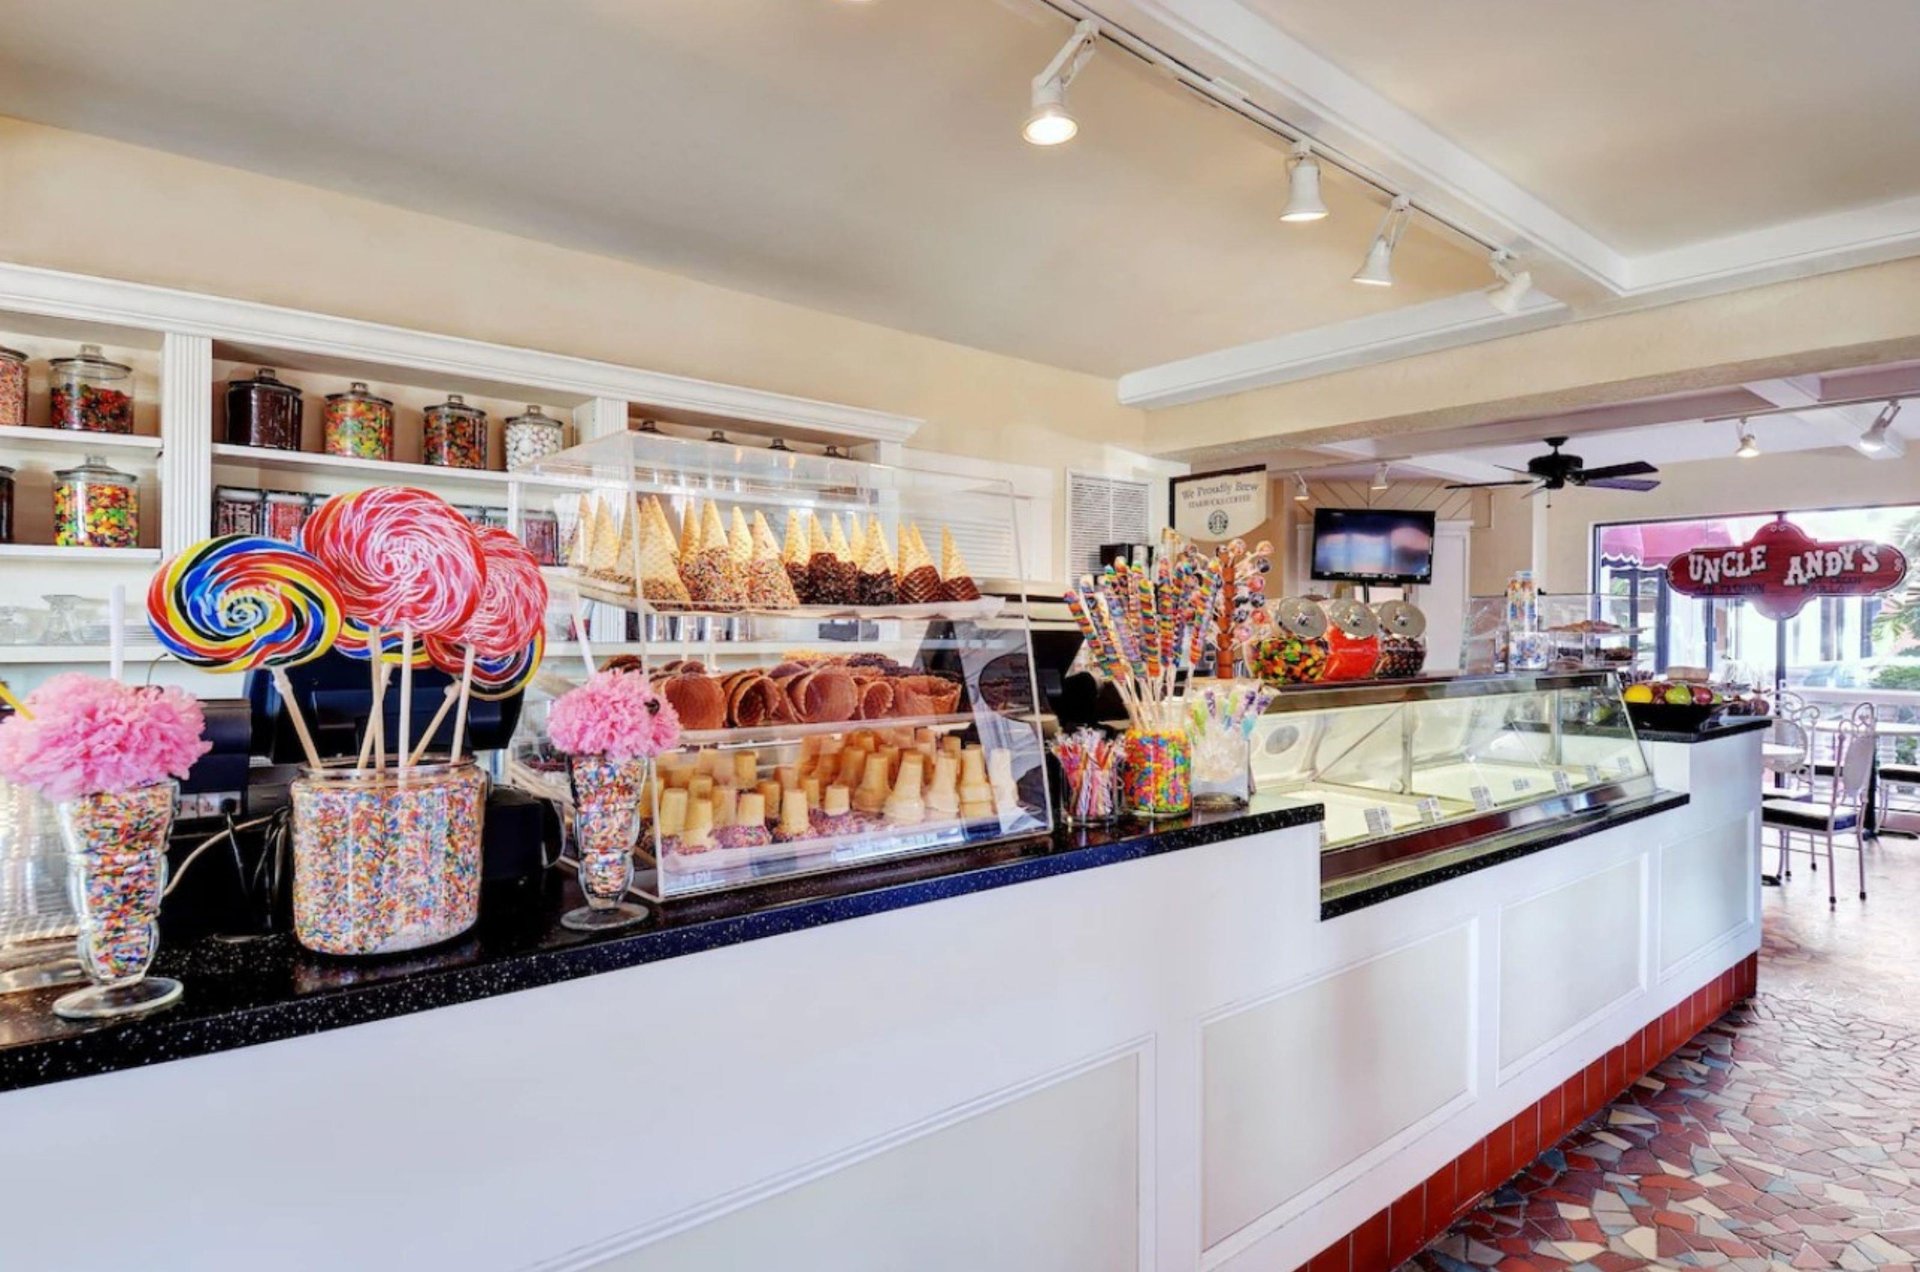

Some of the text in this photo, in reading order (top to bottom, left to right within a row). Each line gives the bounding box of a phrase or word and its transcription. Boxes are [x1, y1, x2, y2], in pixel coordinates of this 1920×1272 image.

[1181, 481, 1259, 500] We Proudly Brew
[1687, 543, 1880, 586] UNCLE ANDY'S
